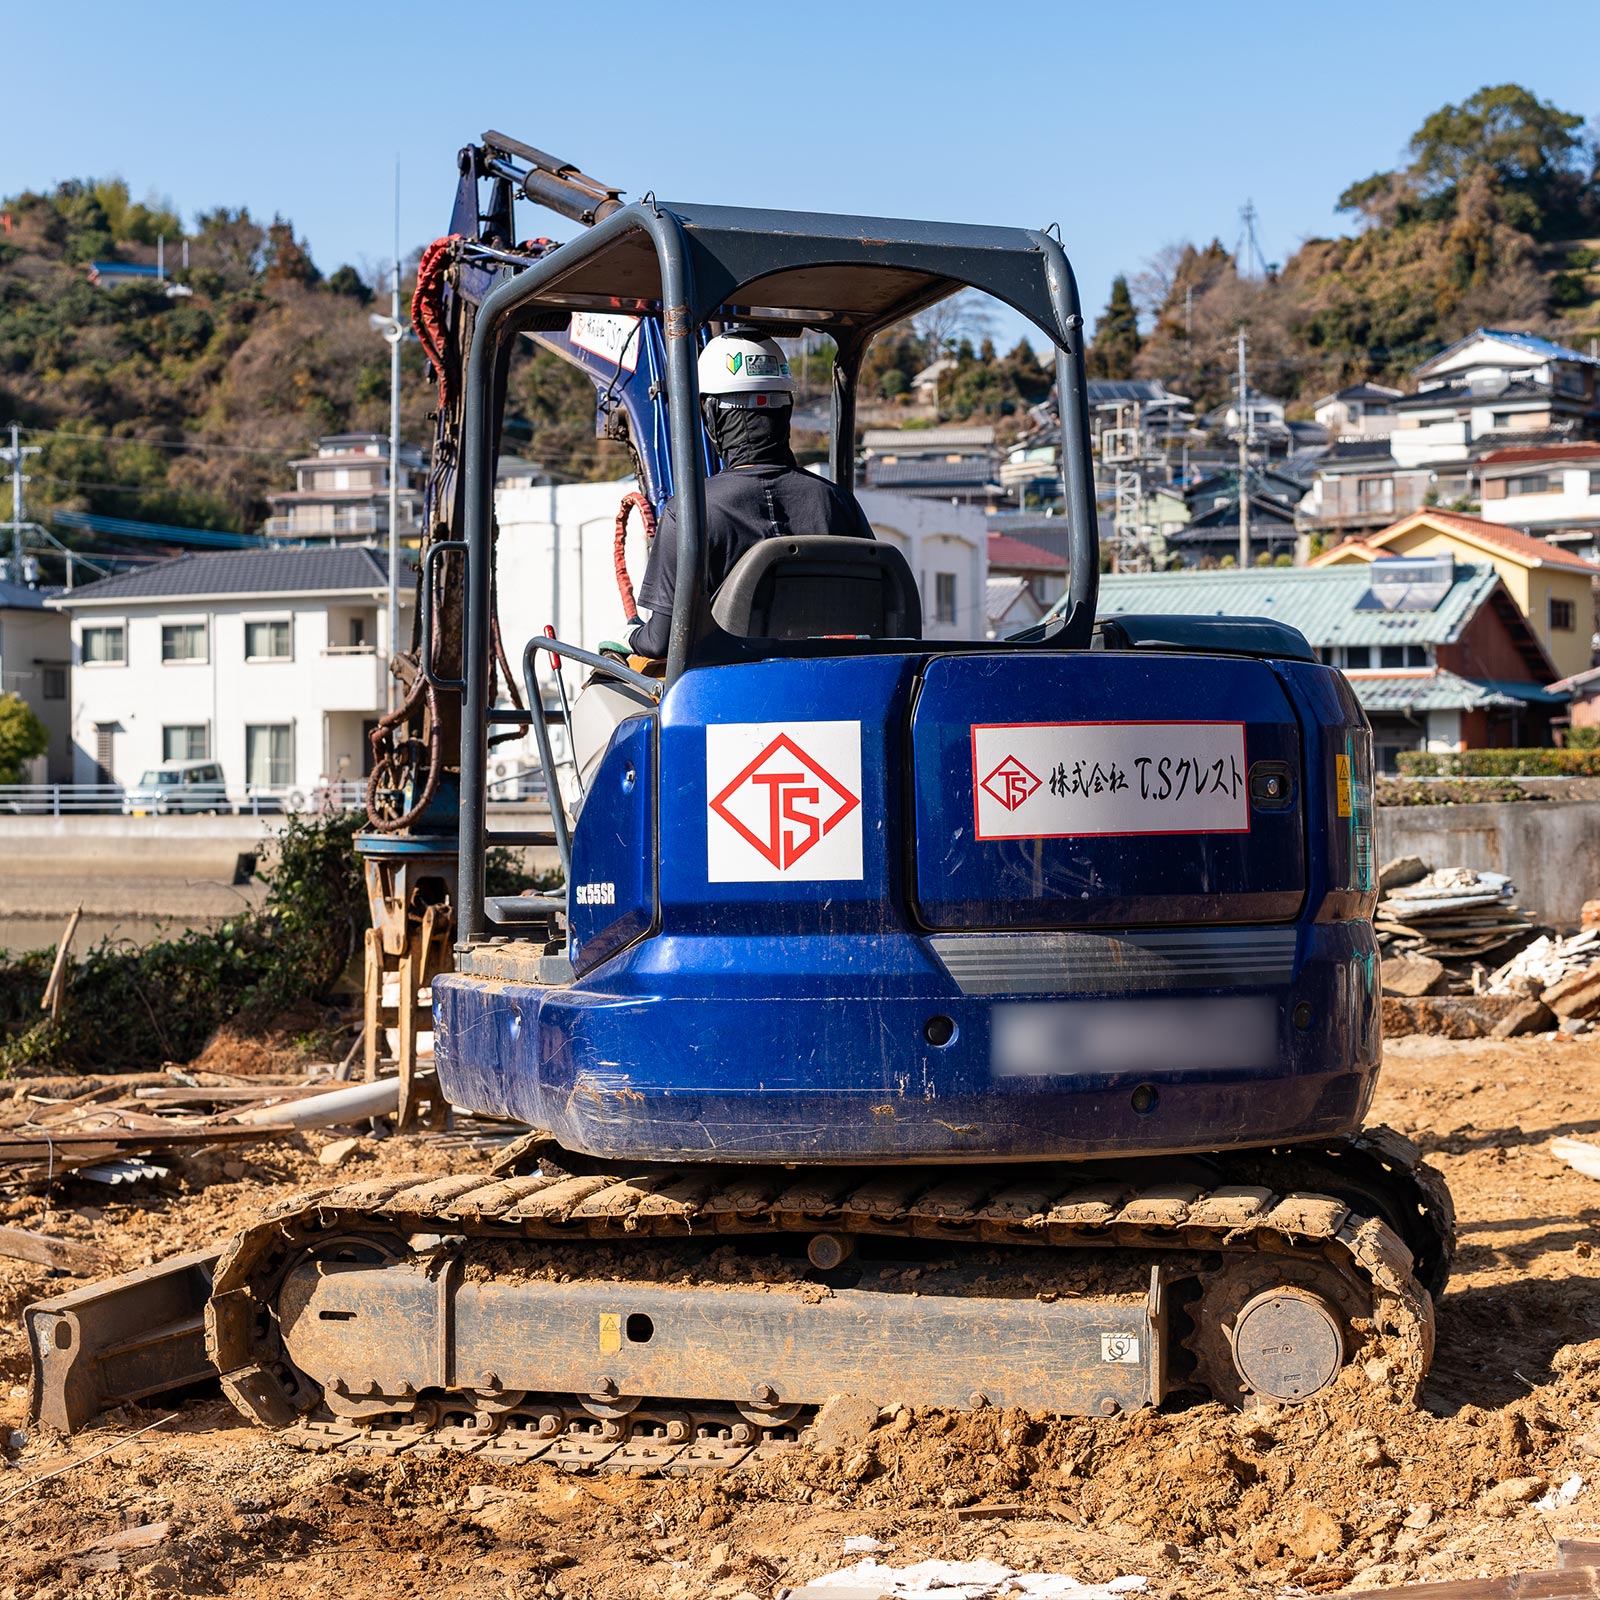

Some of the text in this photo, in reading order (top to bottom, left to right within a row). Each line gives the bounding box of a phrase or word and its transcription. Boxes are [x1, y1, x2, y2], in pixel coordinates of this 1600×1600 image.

[1049, 759, 1129, 798] 株式会社
[751, 772, 820, 871] TS
[576, 882, 616, 905] SK55SR
